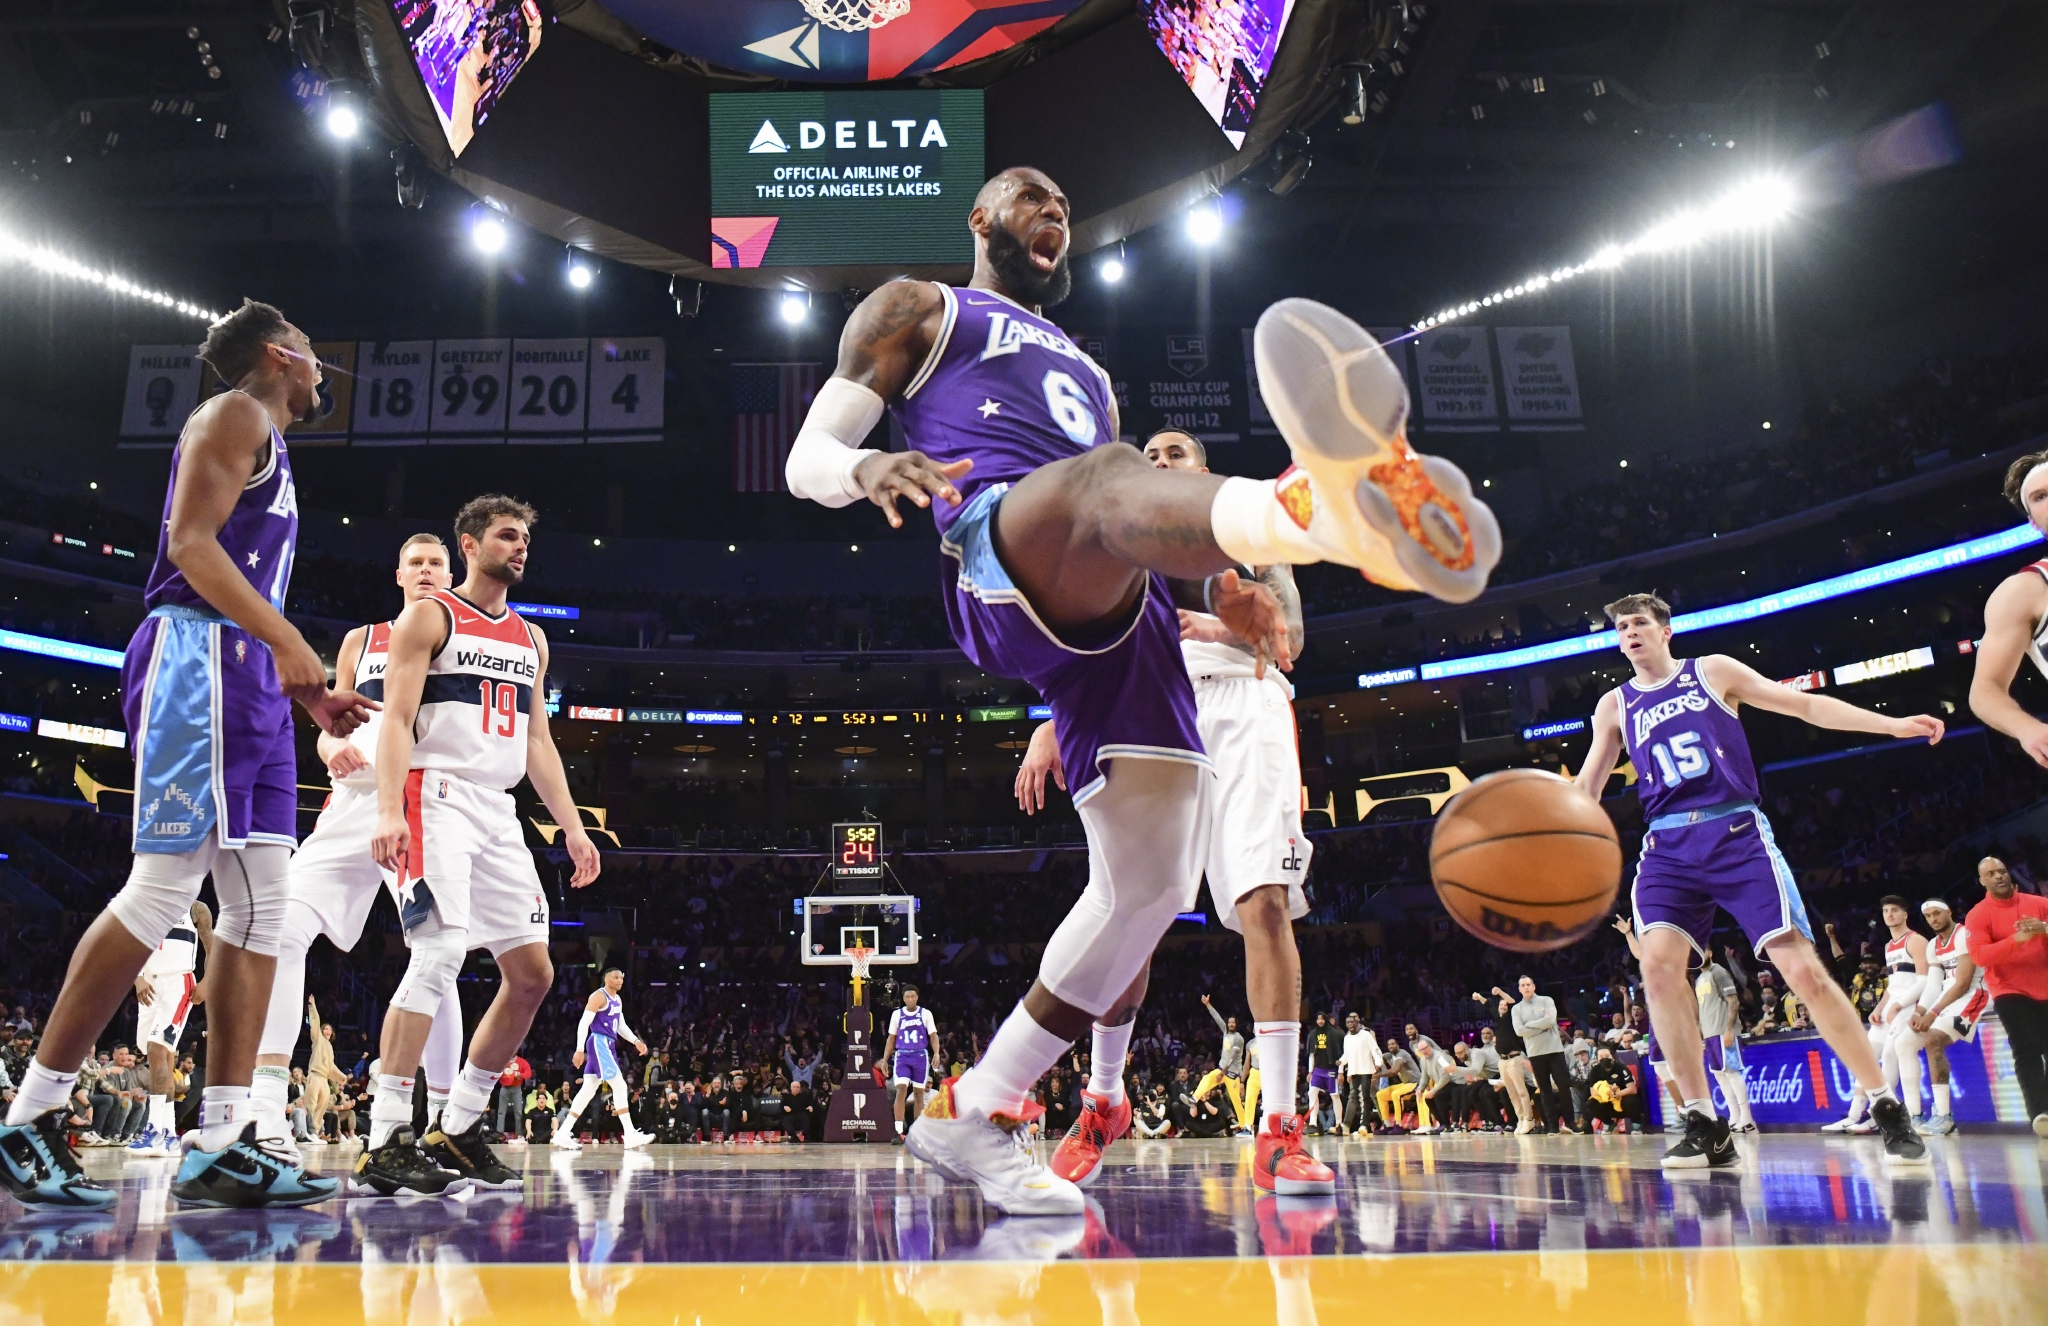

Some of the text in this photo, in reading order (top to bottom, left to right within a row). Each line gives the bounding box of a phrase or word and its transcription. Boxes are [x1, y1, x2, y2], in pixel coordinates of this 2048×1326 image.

[800, 119, 948, 149] DELTA
[773, 165, 923, 180] OFFICIAL AIRLINE OF
[756, 182, 941, 198] THE LOS ANGELES LAKERS
[141, 357, 191, 369] MILLER
[371, 353, 421, 366] TAYLOR
[441, 350, 503, 364] GRETZKY
[515, 351, 584, 363] ROBITAILLE
[605, 349, 651, 362] BLAKE
[442, 374, 499, 416] 99
[518, 374, 577, 416] 20
[611, 373, 640, 414] 4
[1150, 382, 1230, 394] STANLEY CUP
[369, 378, 414, 418] 18
[1151, 395, 1231, 407] CHAMPIONS
[1041, 369, 1097, 447] 6
[1163, 412, 1221, 428] 2011-12
[64, 537, 87, 548] TOYOTA
[1970, 534, 2019, 556] WIRELESS
[114, 547, 135, 558] TOYOTA
[1783, 586, 1825, 606] WIRELESS
[1826, 571, 1882, 595] COVERAGE
[1883, 556, 1940, 579] SOLUTIONS
[543, 607, 567, 616] ULTRA
[3, 635, 42, 652] WIRELESS
[43, 643, 92, 661] COVERAGE
[1446, 659, 1485, 674] WIRELESS
[1486, 652, 1535, 668] COVERAGE
[1537, 642, 1583, 660] SOLUTIONS
[1358, 667, 1414, 688] Spectrum
[479, 678, 518, 738] 19
[578, 706, 613, 721] Coca-Cola
[641, 711, 682, 721] DELTA
[695, 712, 744, 724] crypto.com
[789, 713, 803, 725] 72
[843, 713, 867, 725] 5:52
[870, 715, 876, 724] 3
[912, 712, 927, 723] 71
[1633, 688, 1709, 749] LAKERS
[1533, 719, 1585, 738] crypto.com
[1651, 730, 1710, 788] 15
[145, 783, 205, 821] LOS ANGELES
[154, 822, 191, 835] LAKERS
[847, 828, 876, 841] 5:52
[843, 842, 873, 864] 24
[904, 1030, 919, 1044] 14
